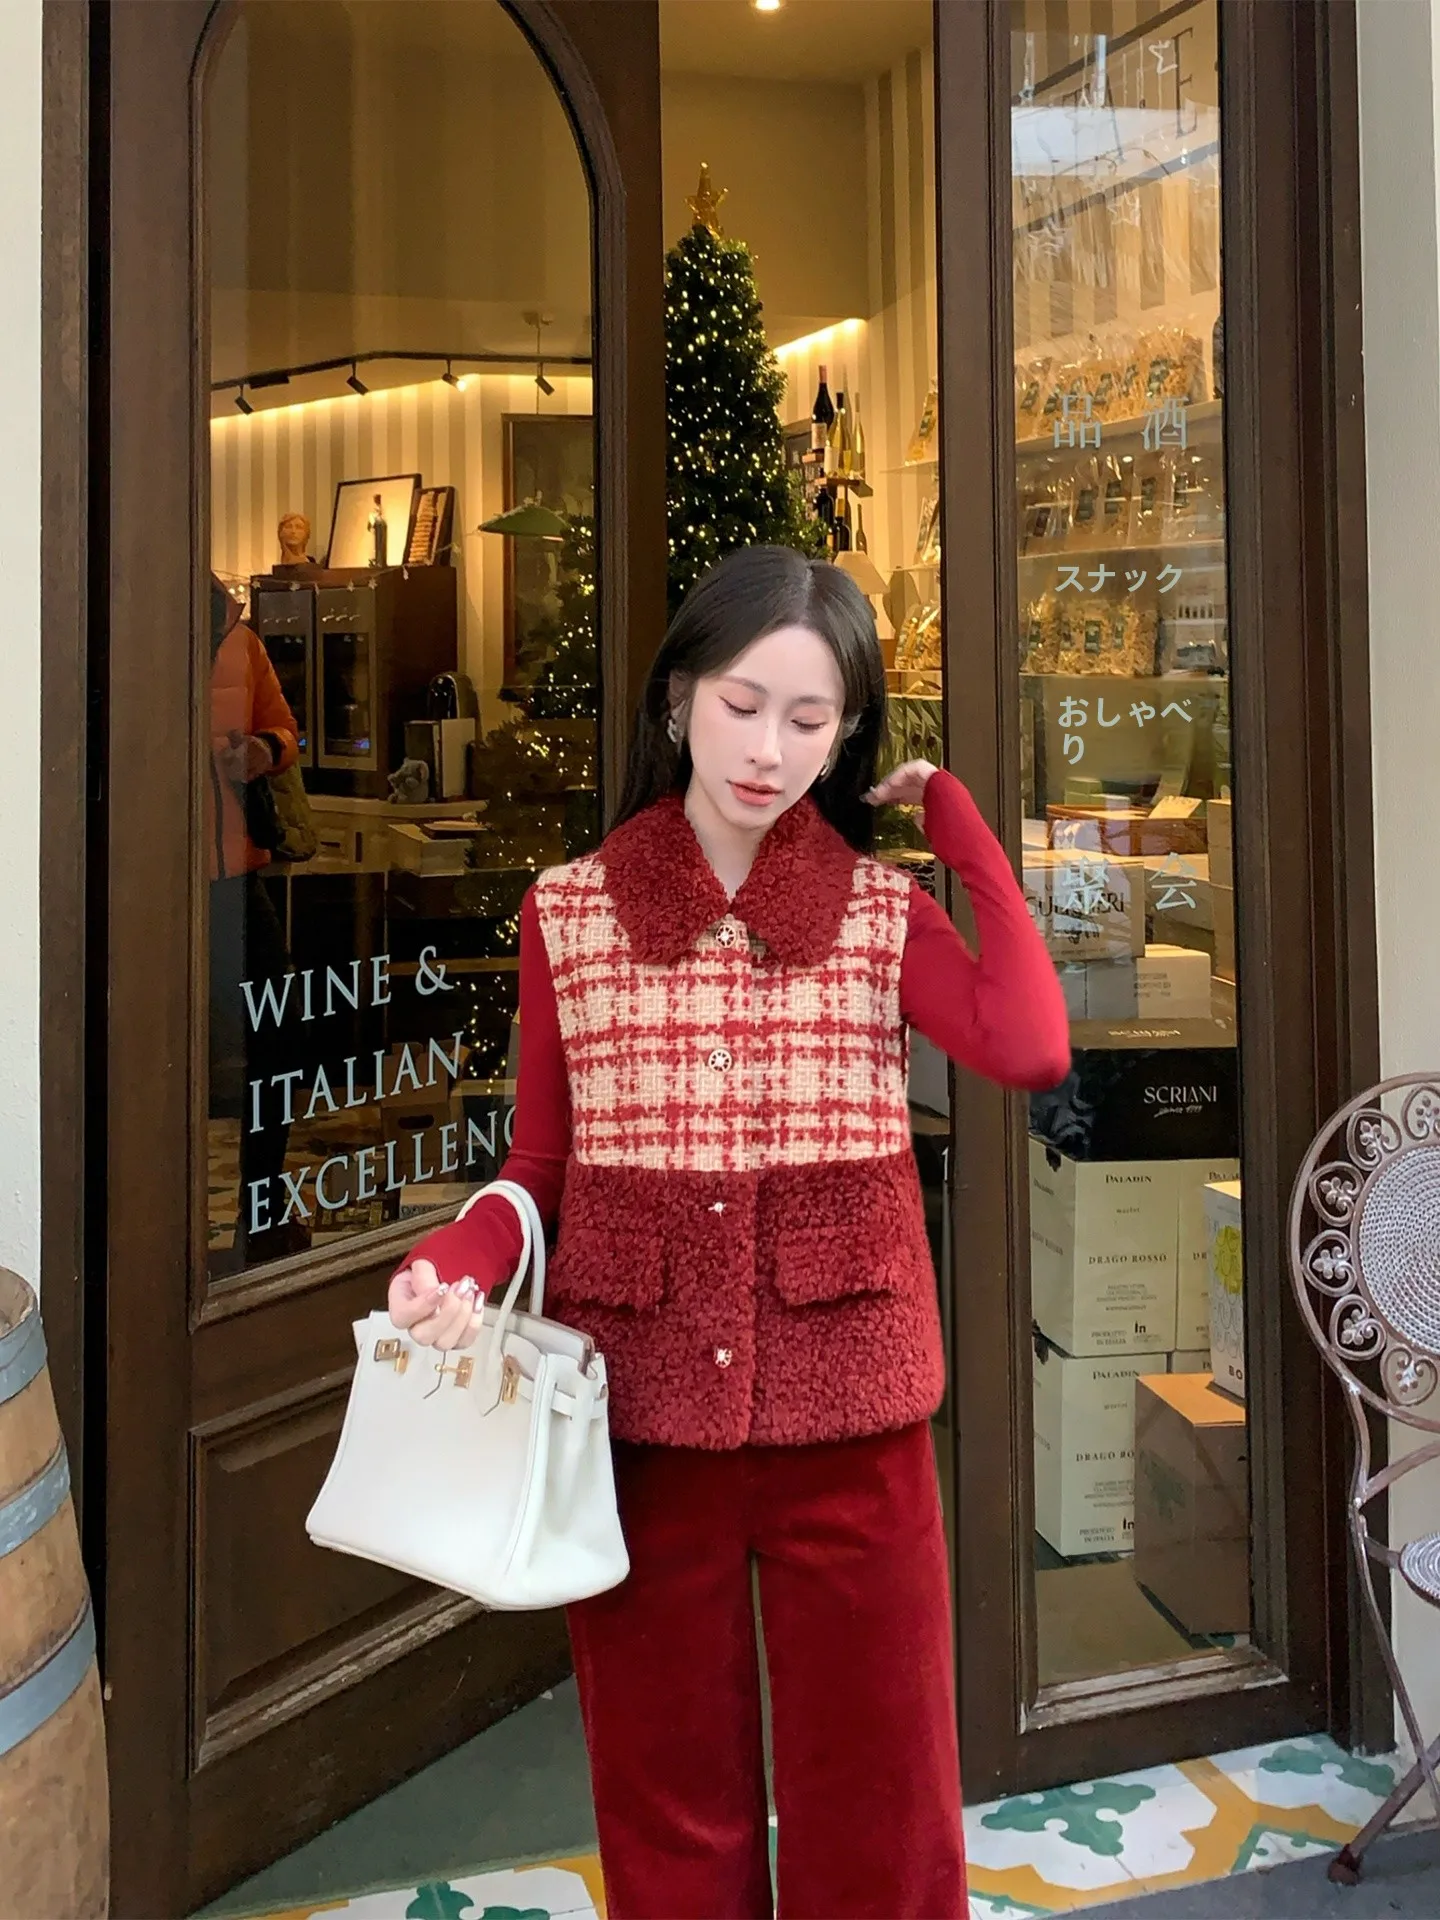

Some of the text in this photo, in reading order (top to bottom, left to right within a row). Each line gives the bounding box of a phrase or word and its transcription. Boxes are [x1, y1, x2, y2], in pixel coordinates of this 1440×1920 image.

[1055, 563, 1183, 593] スナック
[1058, 695, 1193, 728] おしゃべ
[1063, 733, 1085, 765] り
[239, 945, 455, 1032] WINE &
[249, 1030, 465, 1134] ITALIAN
[1143, 1085, 1217, 1104] SCRIANI
[1088, 1253, 1167, 1265] DRAGO ROSSO
[1134, 1320, 1146, 1334] In
